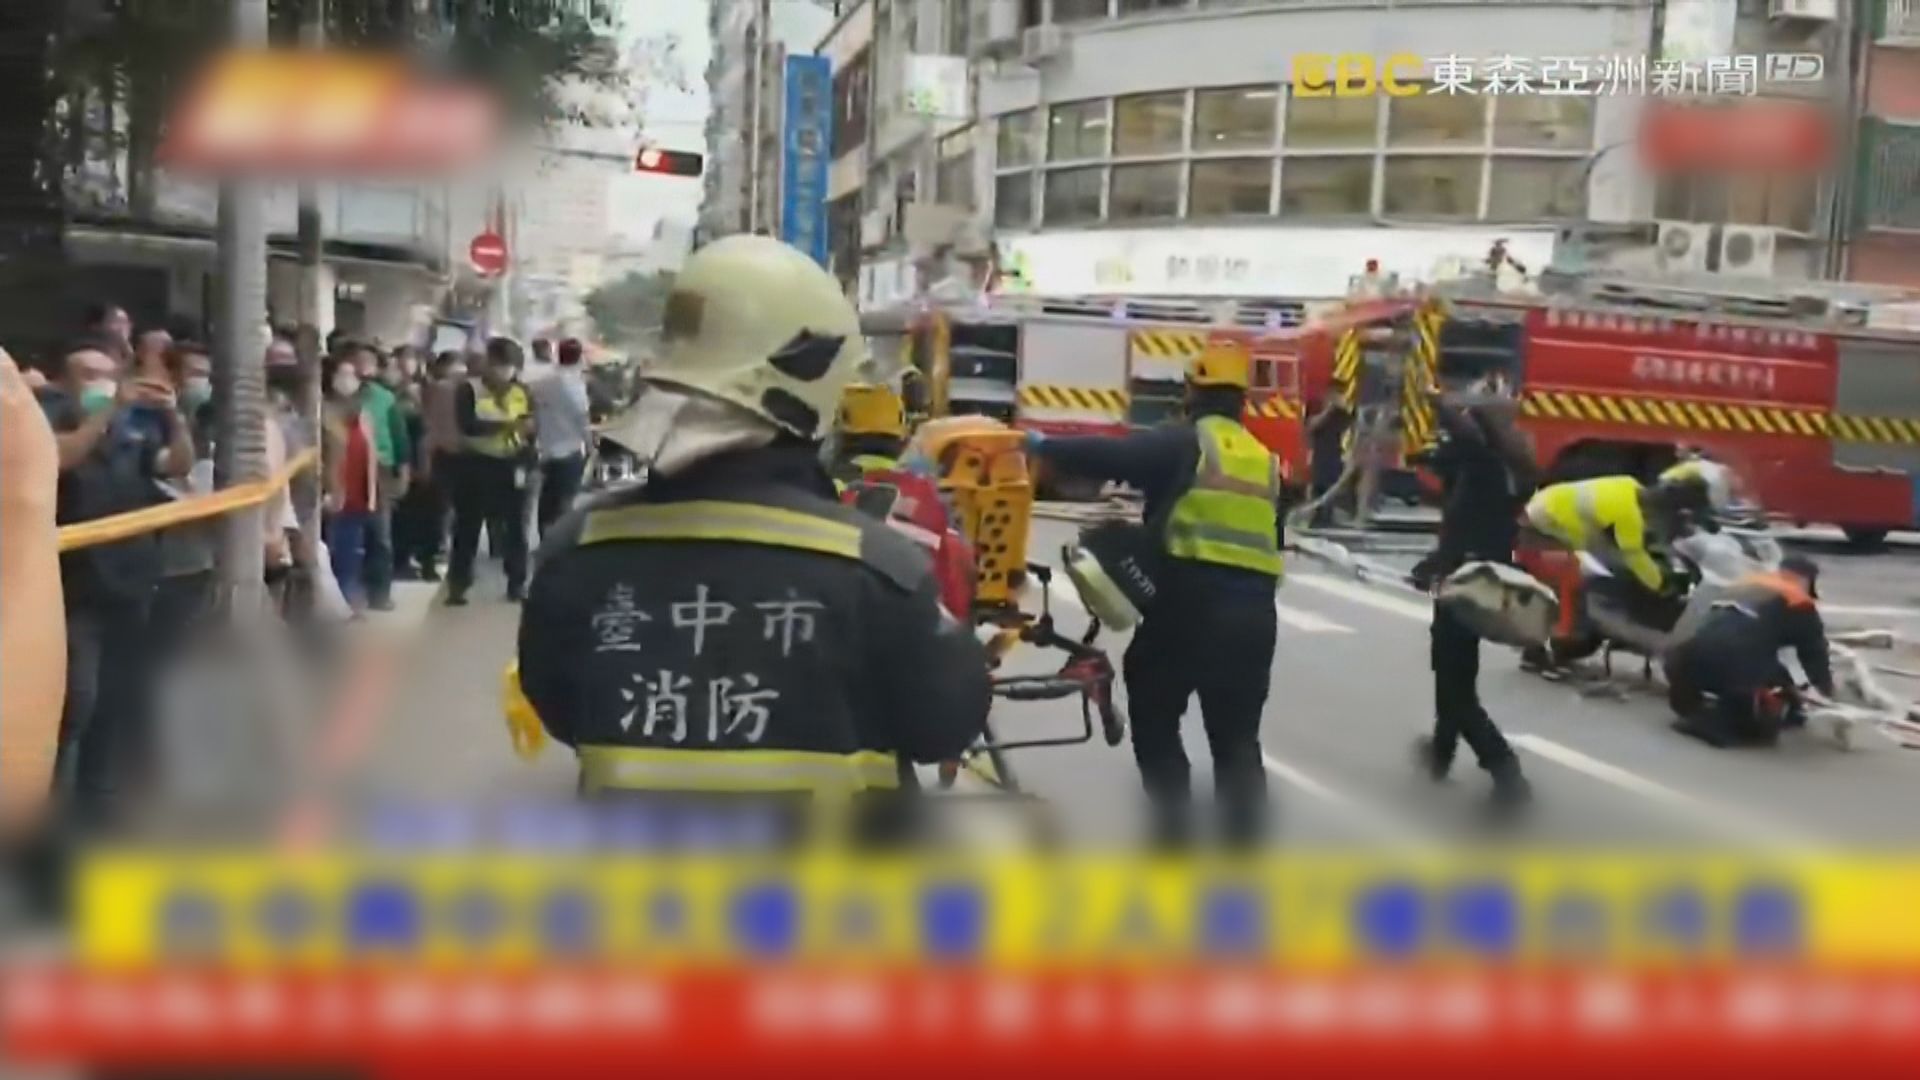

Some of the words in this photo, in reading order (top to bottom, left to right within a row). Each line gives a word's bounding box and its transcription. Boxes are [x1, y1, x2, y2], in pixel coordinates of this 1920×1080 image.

[592, 582, 826, 656] 臺中市
[620, 669, 780, 742] 消防
